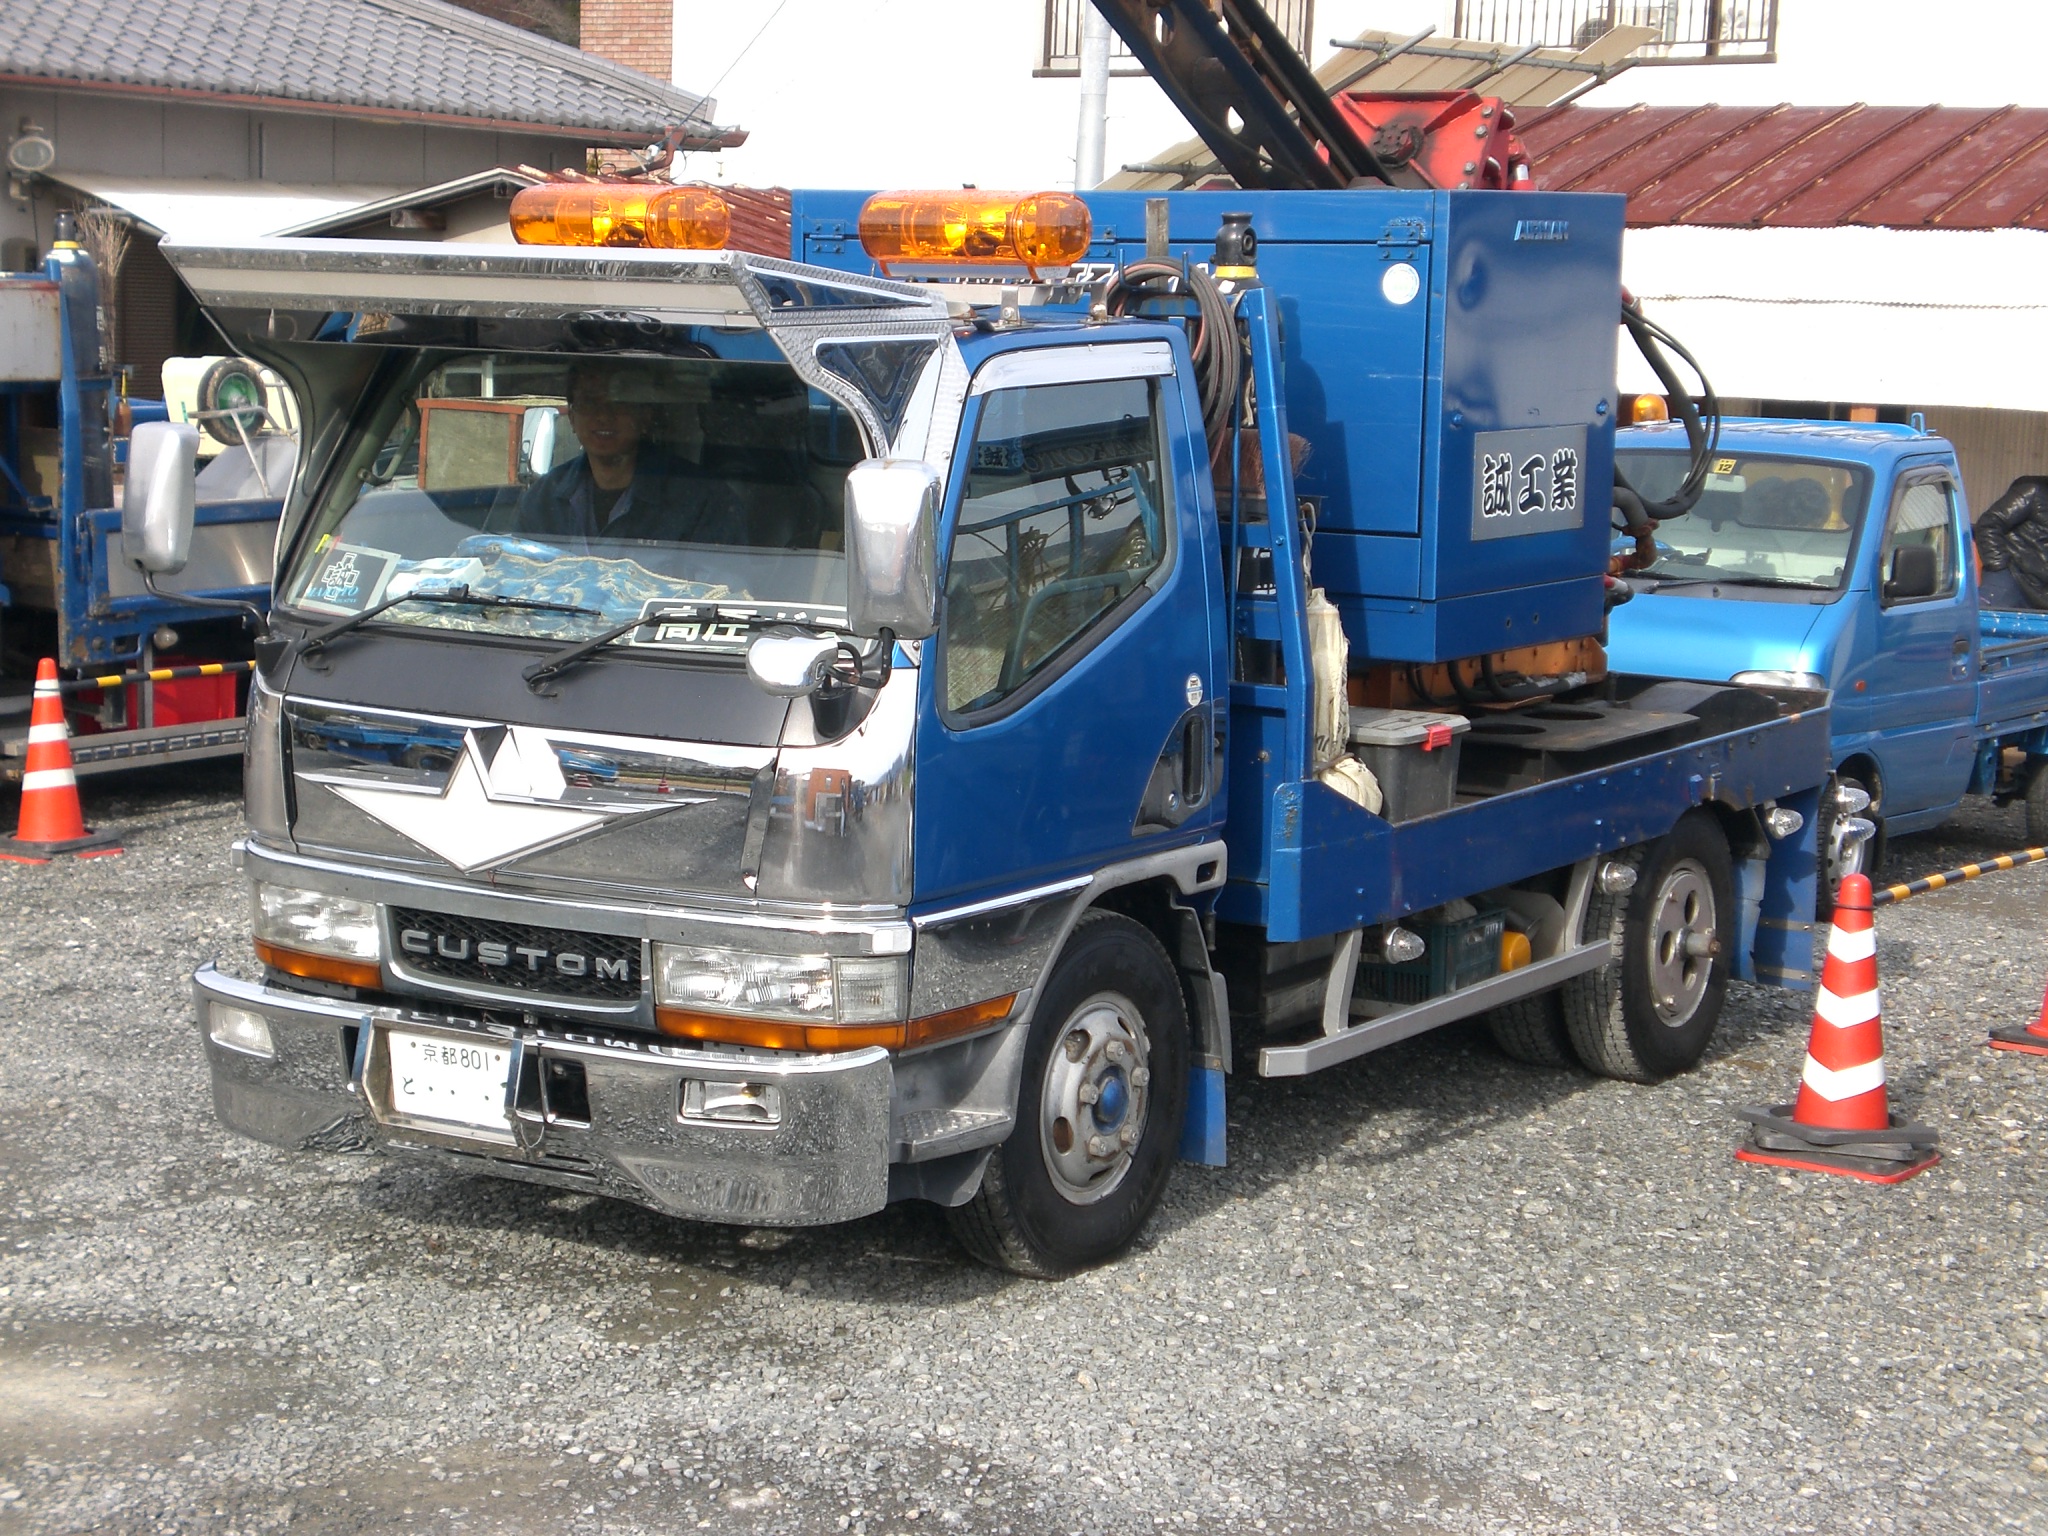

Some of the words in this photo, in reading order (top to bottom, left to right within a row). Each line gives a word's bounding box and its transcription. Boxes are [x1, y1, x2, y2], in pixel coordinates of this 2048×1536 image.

[1482, 448, 1578, 517] 誠工業
[1719, 463, 1732, 472] 12
[401, 930, 629, 981] CUSTOM
